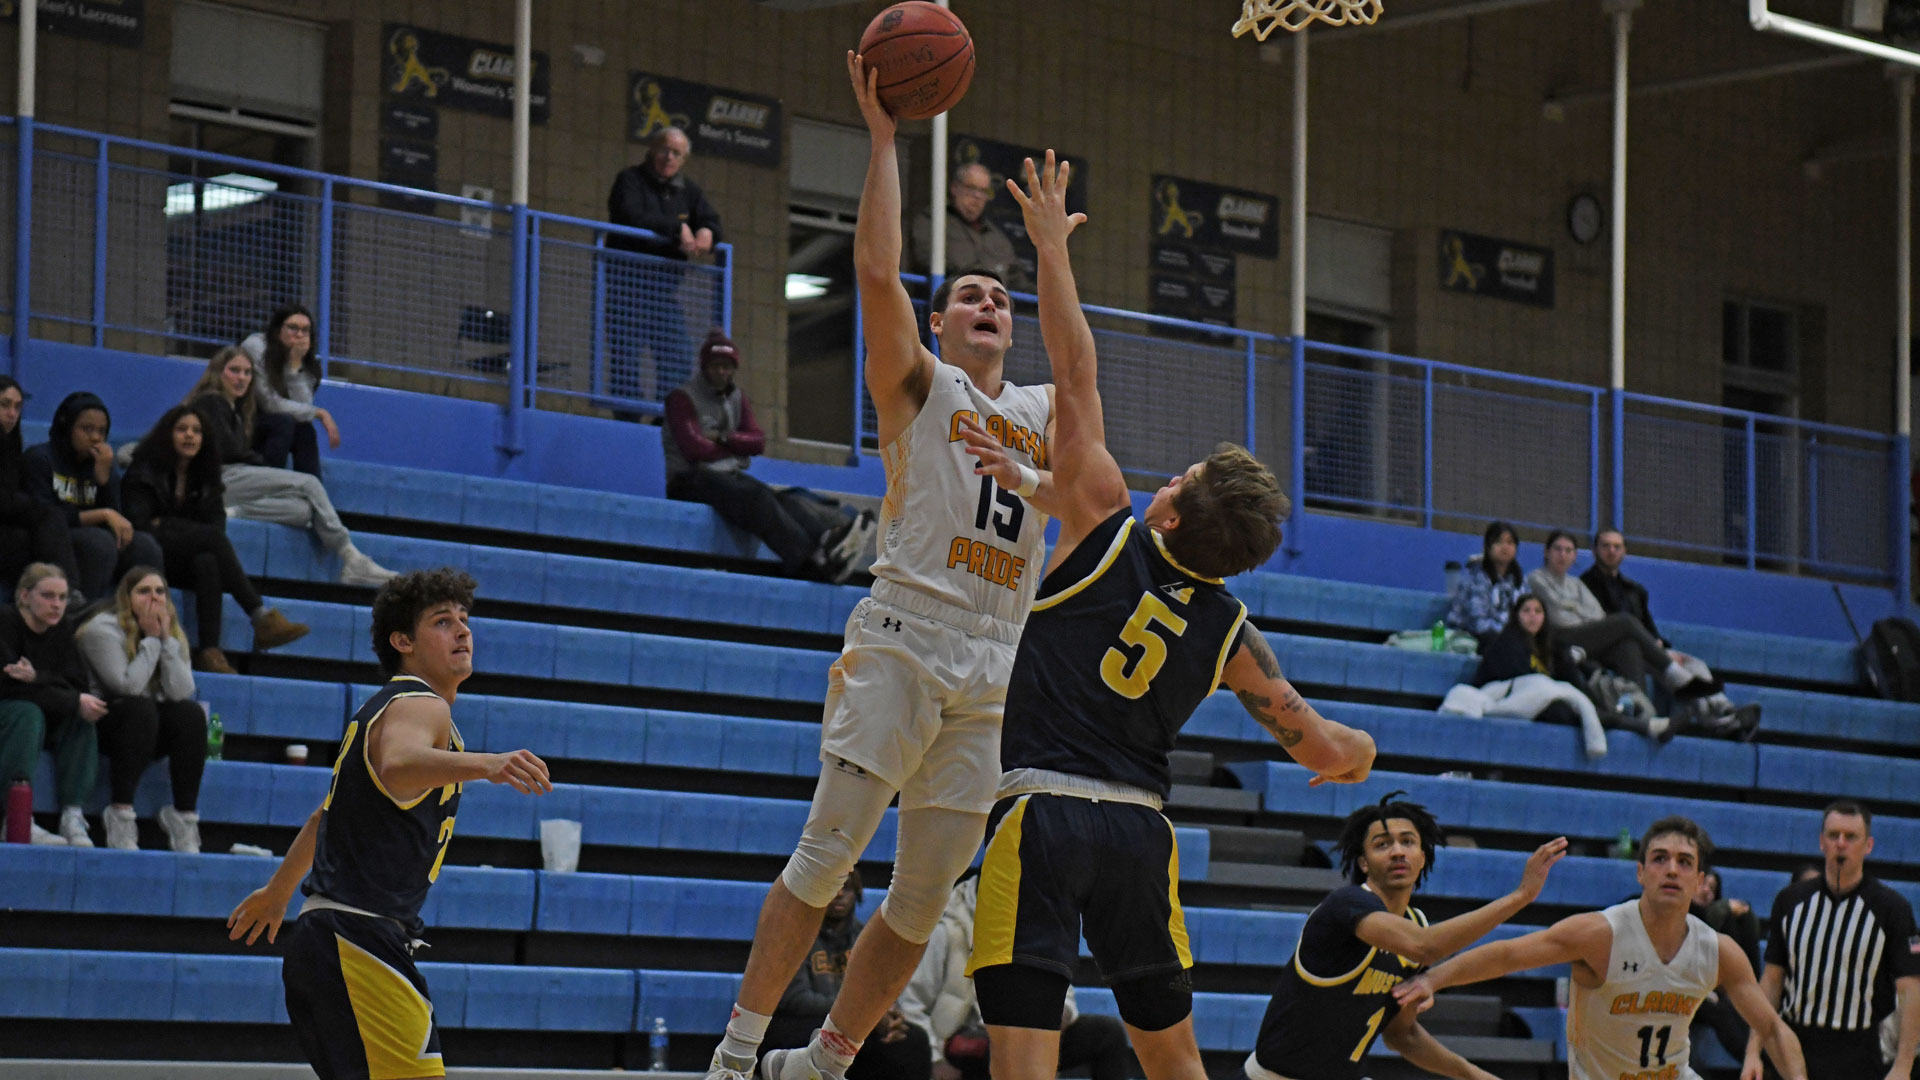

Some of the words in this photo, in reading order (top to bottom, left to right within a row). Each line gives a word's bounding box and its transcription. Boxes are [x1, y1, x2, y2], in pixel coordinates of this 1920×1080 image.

[79, 3, 137, 27] Lacrosse
[975, 460, 1024, 542] 15
[947, 536, 1026, 591] PRIDE
[1100, 590, 1188, 699] 5
[1350, 1006, 1386, 1062] 1
[1638, 1026, 1672, 1068] 11
